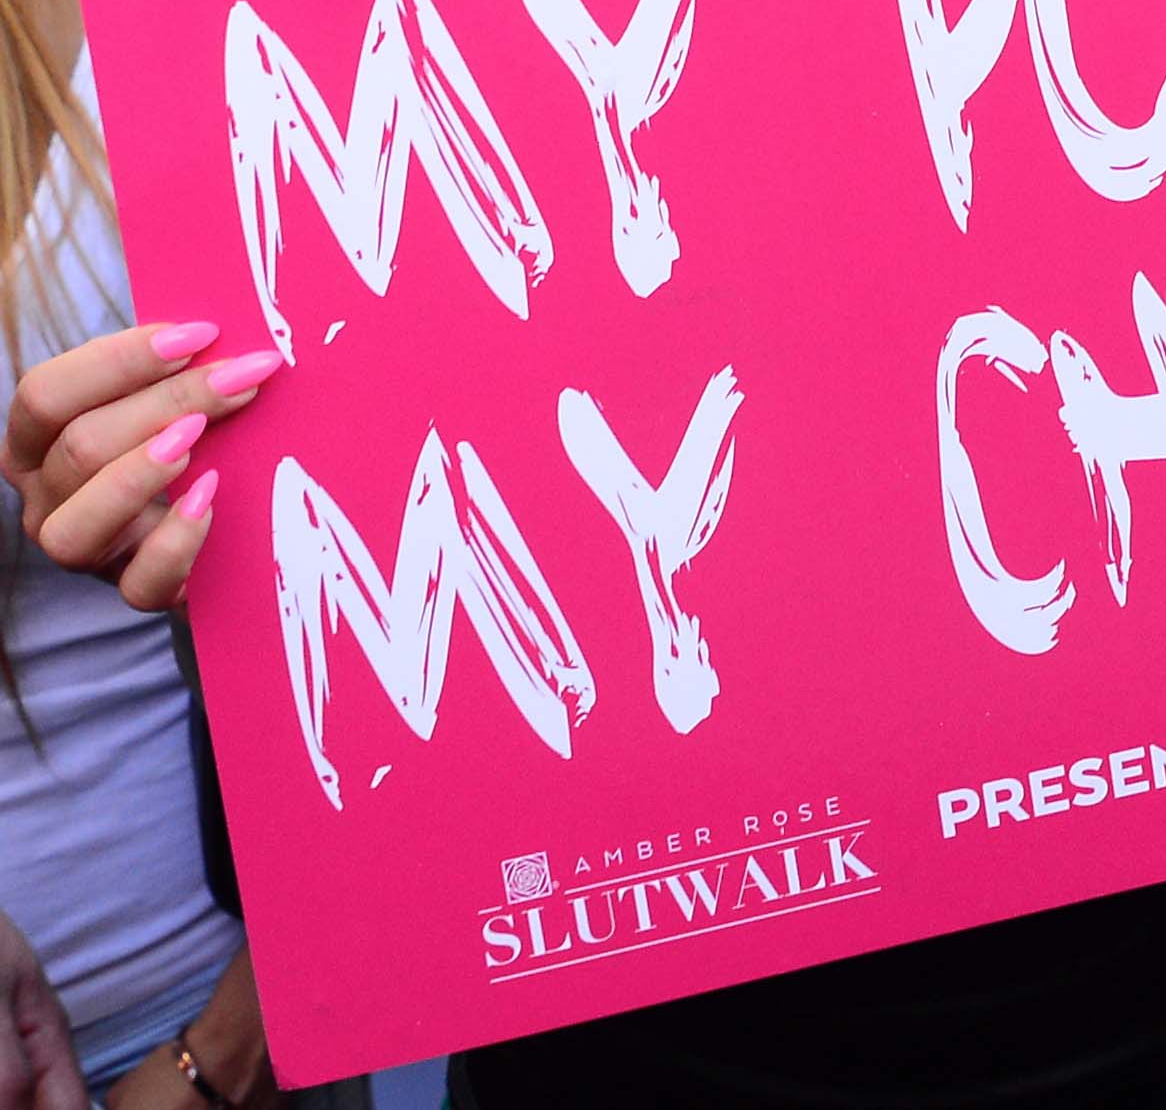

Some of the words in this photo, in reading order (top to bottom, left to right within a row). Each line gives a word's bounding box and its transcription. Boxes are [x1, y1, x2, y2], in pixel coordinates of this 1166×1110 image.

[272, 364, 745, 811] MY
[481, 831, 879, 968] SLUTWALK
[573, 827, 712, 875] AMBER
[743, 795, 841, 835] ROSE
